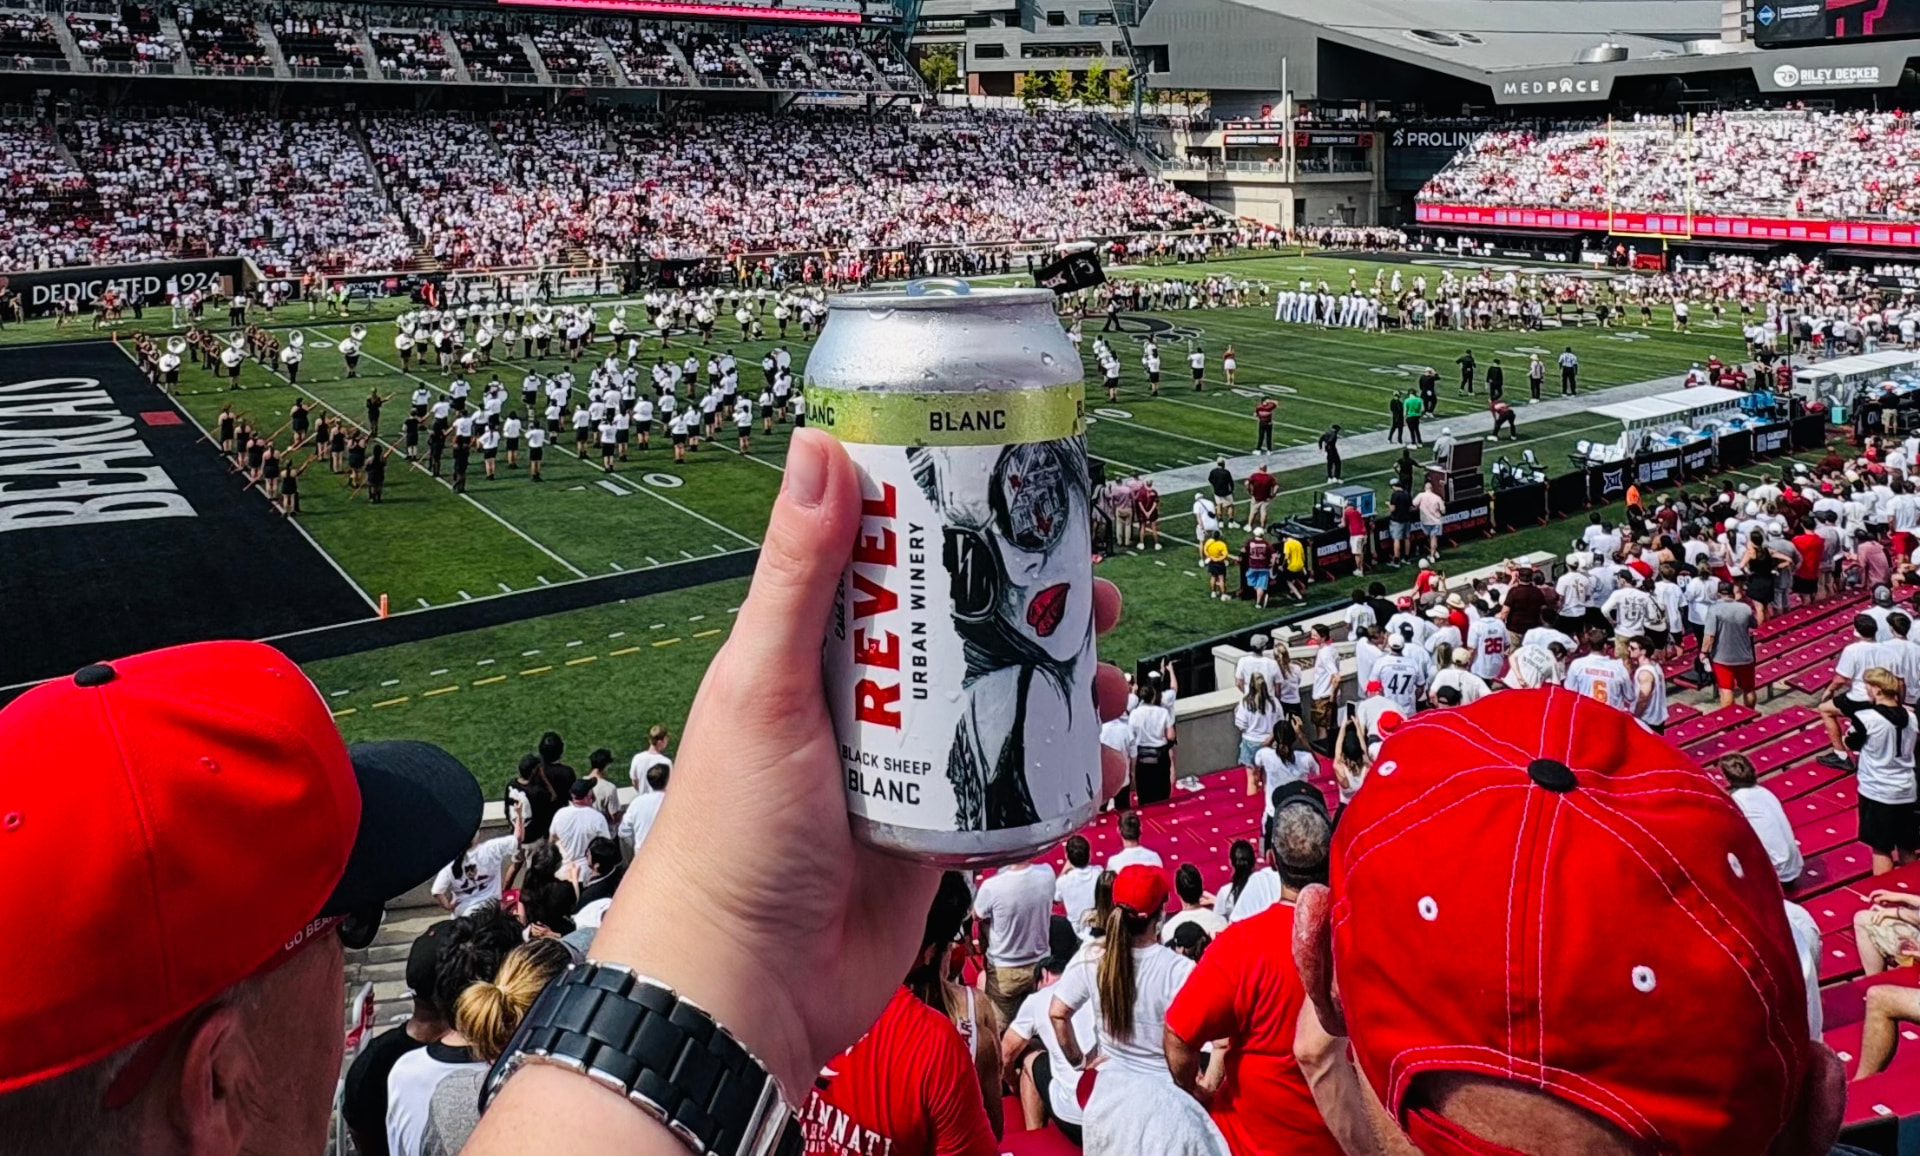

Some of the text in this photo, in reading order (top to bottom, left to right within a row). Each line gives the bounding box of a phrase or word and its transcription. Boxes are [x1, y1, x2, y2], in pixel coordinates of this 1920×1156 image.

[1801, 67, 1879, 80] RILEY DECKER
[1503, 77, 1600, 94] MEDPACE
[929, 410, 1006, 431] BLANC
[852, 482, 902, 731] REVEL
[908, 522, 928, 699] URBAN WINERY
[1484, 638, 1503, 655] 26
[1387, 673, 1412, 695] 47
[1593, 680, 1608, 703] 6
[842, 744, 932, 776] BLACK SHEEP
[848, 768, 921, 806] BLANC
[285, 930, 303, 951] GO
